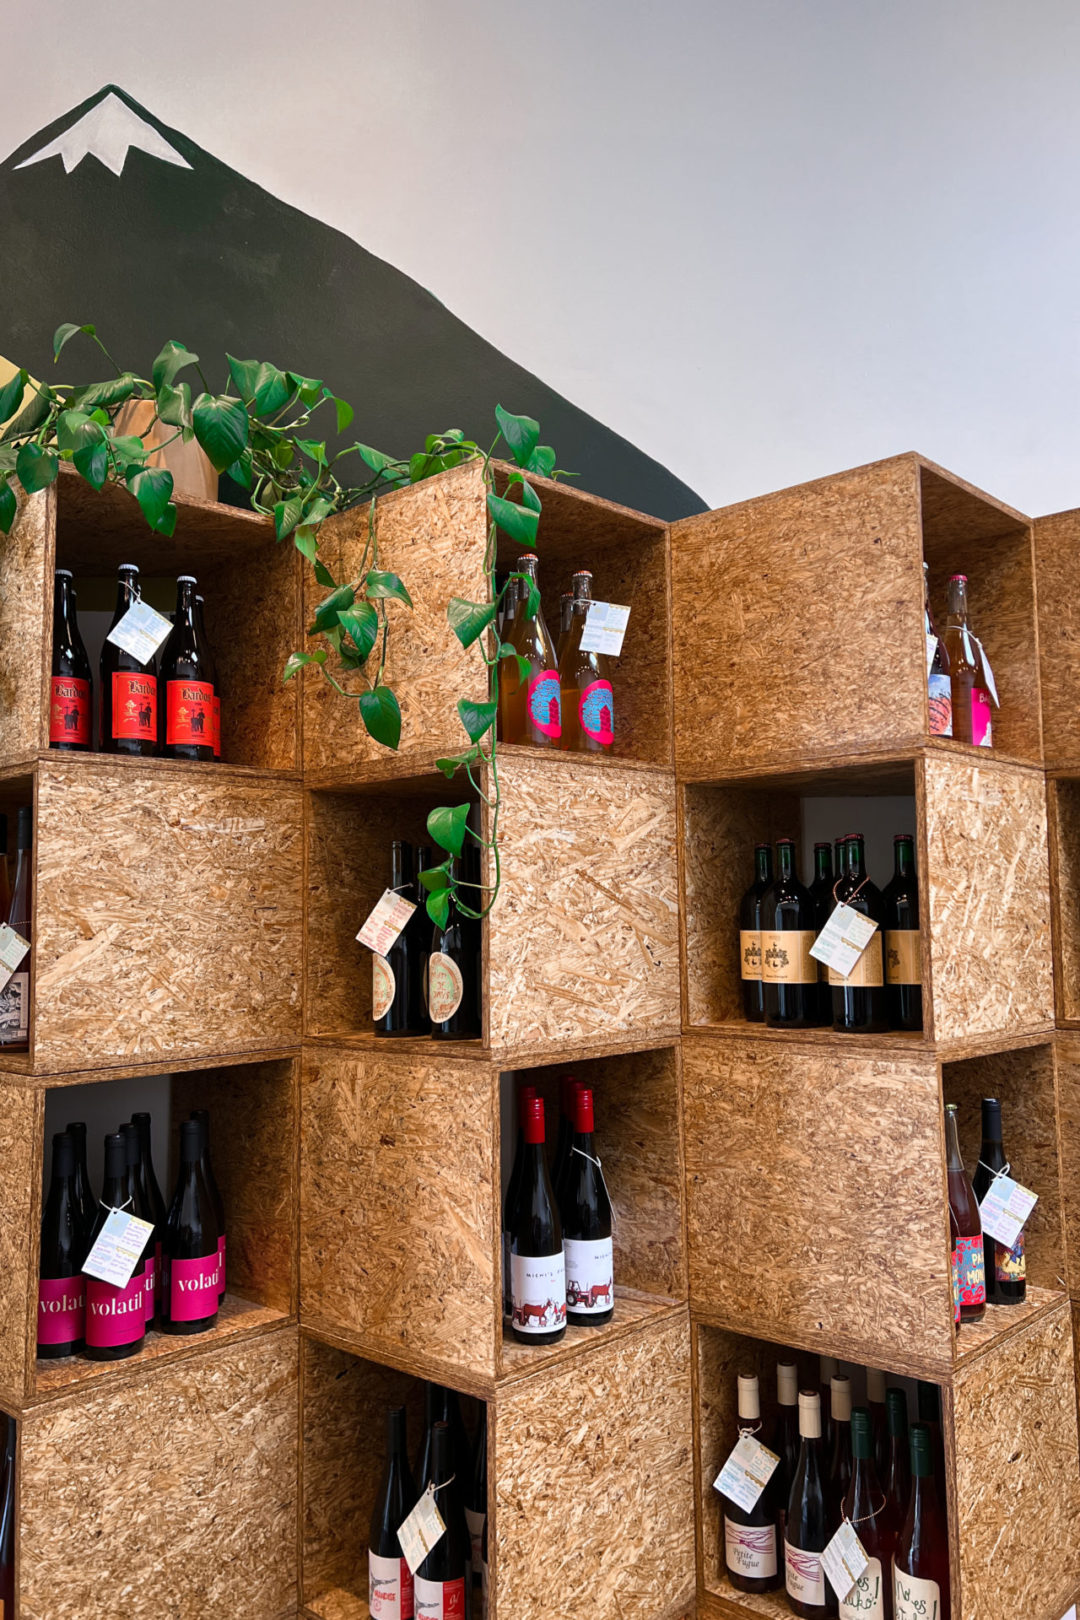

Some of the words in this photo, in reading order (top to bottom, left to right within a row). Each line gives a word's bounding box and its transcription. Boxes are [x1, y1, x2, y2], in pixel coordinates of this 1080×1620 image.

[129, 680, 156, 697] Bardo
[178, 1268, 219, 1292] volati
[91, 1291, 142, 1316] volatil
[733, 1547, 754, 1560] Petite
[736, 1556, 760, 1569] Fugue
[897, 1581, 911, 1602] No
[911, 1599, 926, 1615] es
